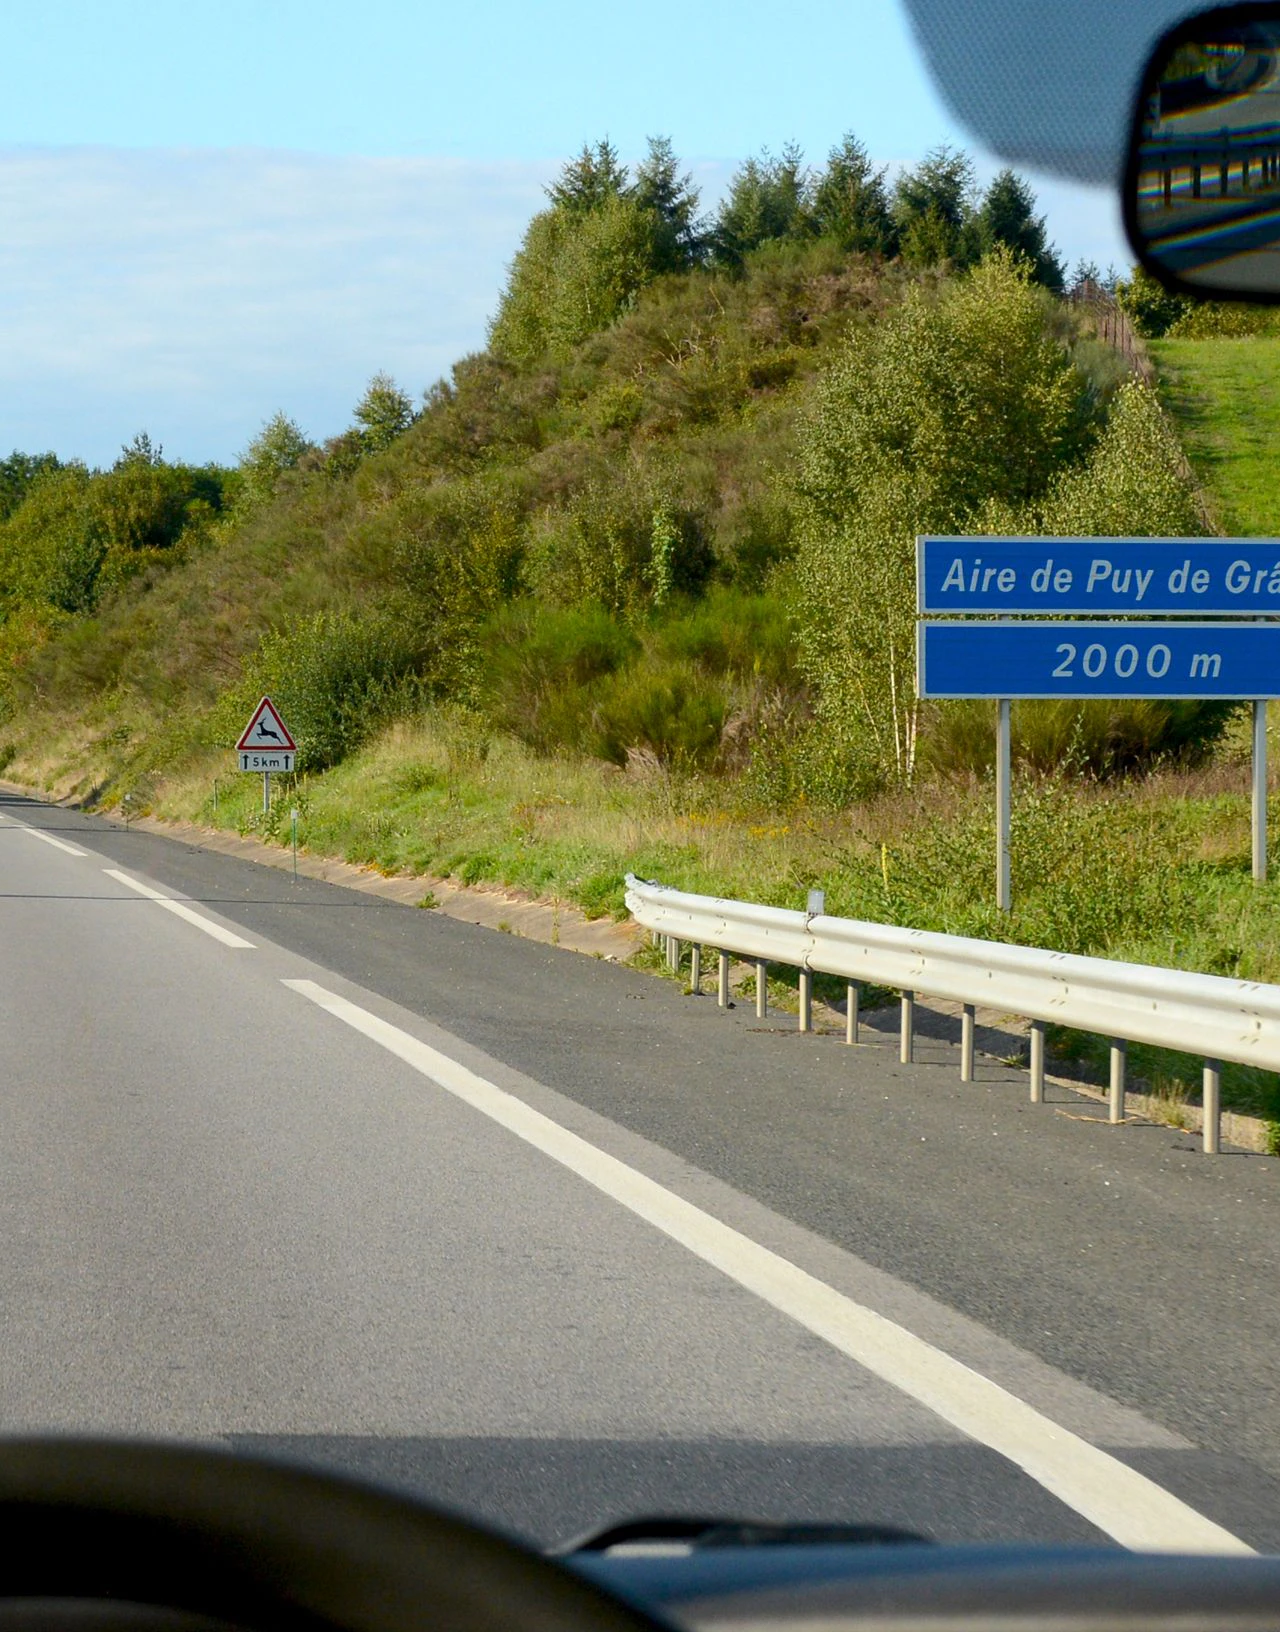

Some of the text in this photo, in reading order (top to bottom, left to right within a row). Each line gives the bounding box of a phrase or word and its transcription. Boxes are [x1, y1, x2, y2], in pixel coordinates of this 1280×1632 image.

[942, 559, 1015, 592] Aire
[1031, 560, 1072, 592] de
[1087, 560, 1153, 601] Puy
[1169, 560, 1210, 593] de
[1053, 644, 1221, 677] 2000 m
